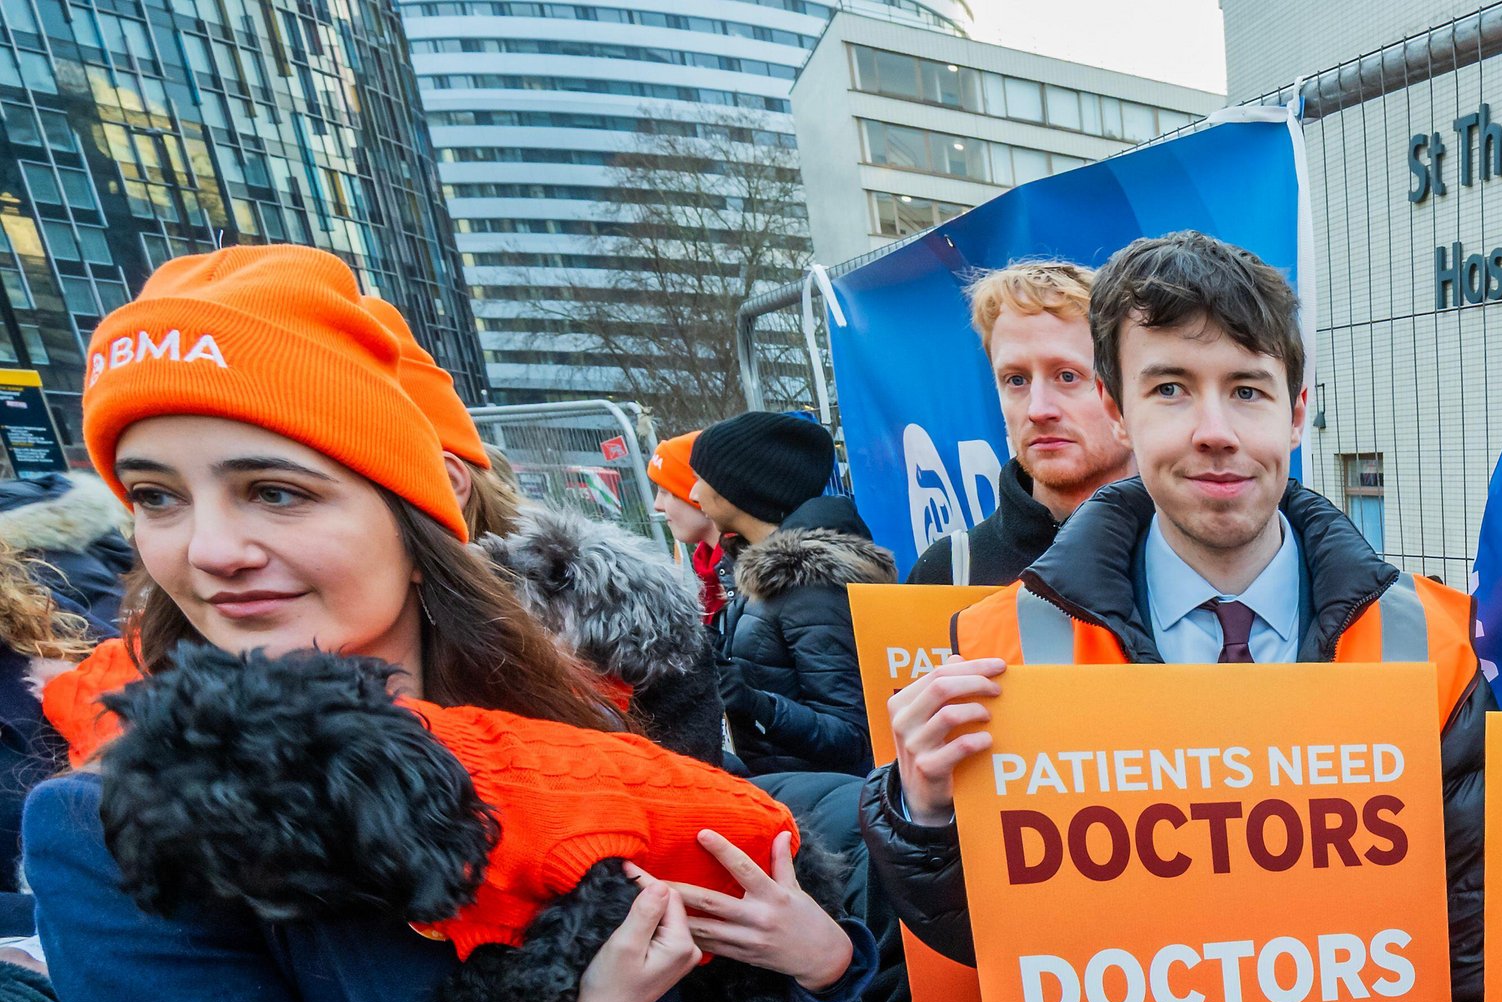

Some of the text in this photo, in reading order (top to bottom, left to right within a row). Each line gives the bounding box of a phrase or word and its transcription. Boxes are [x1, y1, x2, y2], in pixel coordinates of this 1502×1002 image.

[1408, 132, 1446, 203] St
[110, 329, 228, 369] BMA
[992, 743, 1405, 796] PATIENTS NEED
[1000, 794, 1408, 886] DOCTORS
